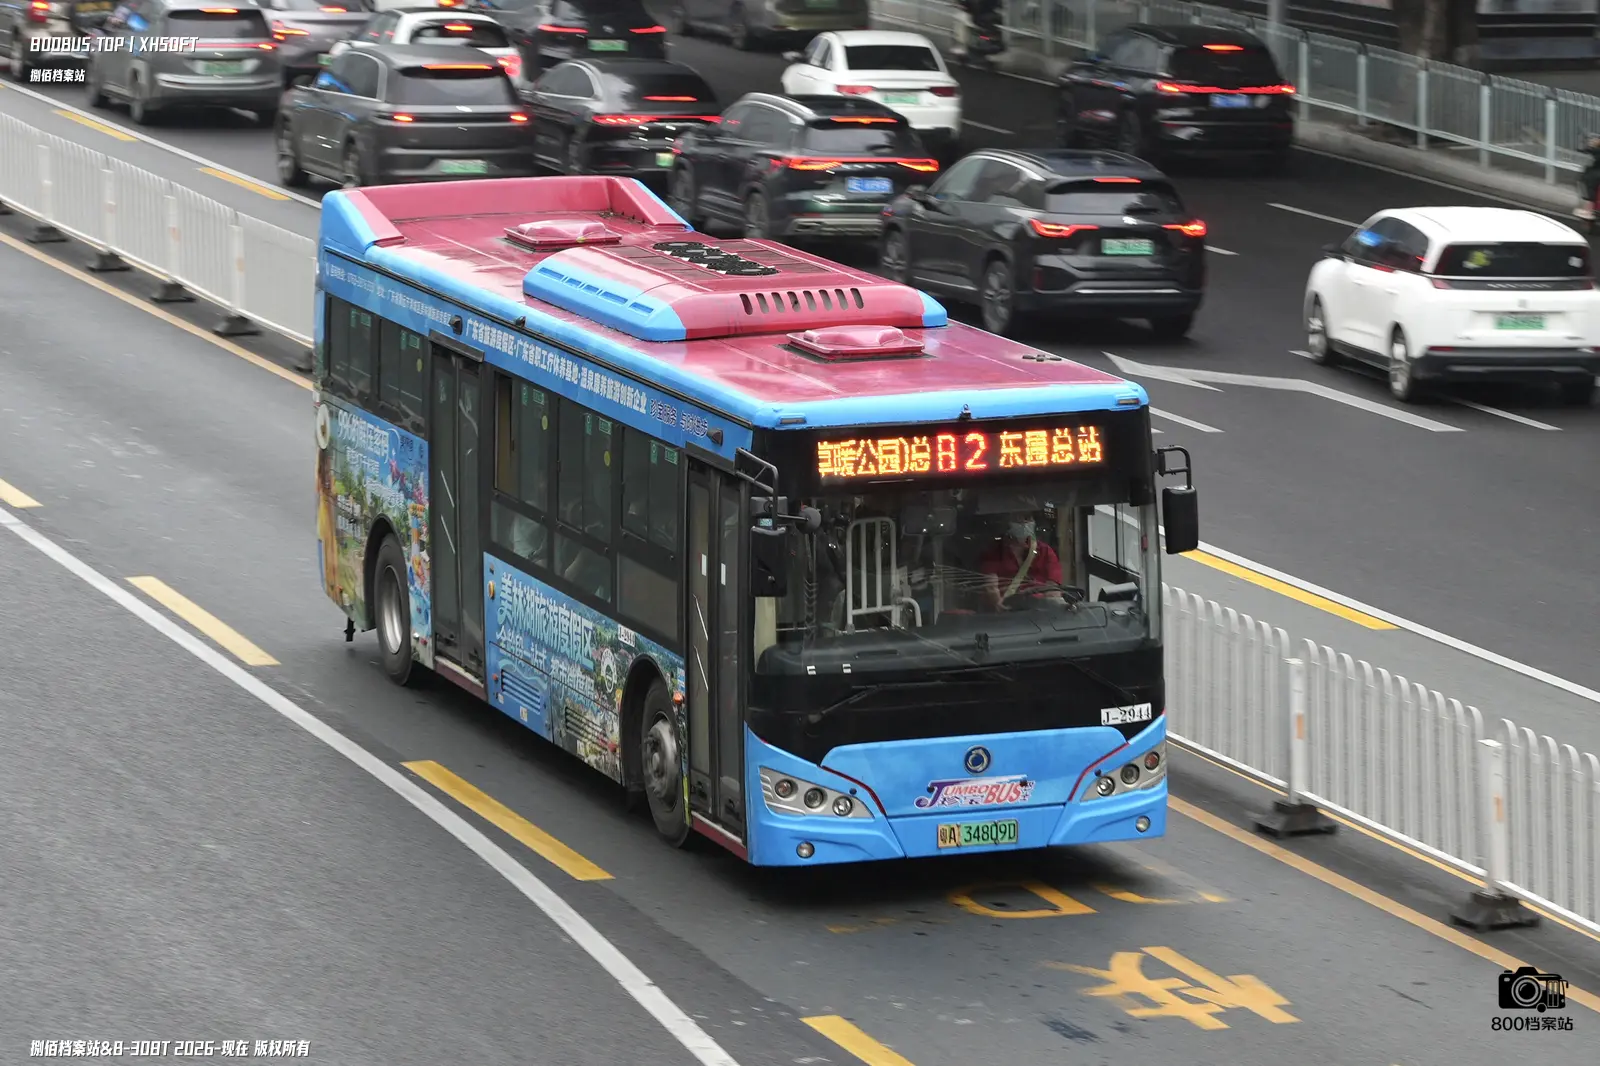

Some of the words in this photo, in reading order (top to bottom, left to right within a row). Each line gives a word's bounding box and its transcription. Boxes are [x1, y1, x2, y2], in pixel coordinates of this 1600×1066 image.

[497, 571, 595, 672] 美林湖旅游度假区
[1102, 704, 1151, 725] J-2944
